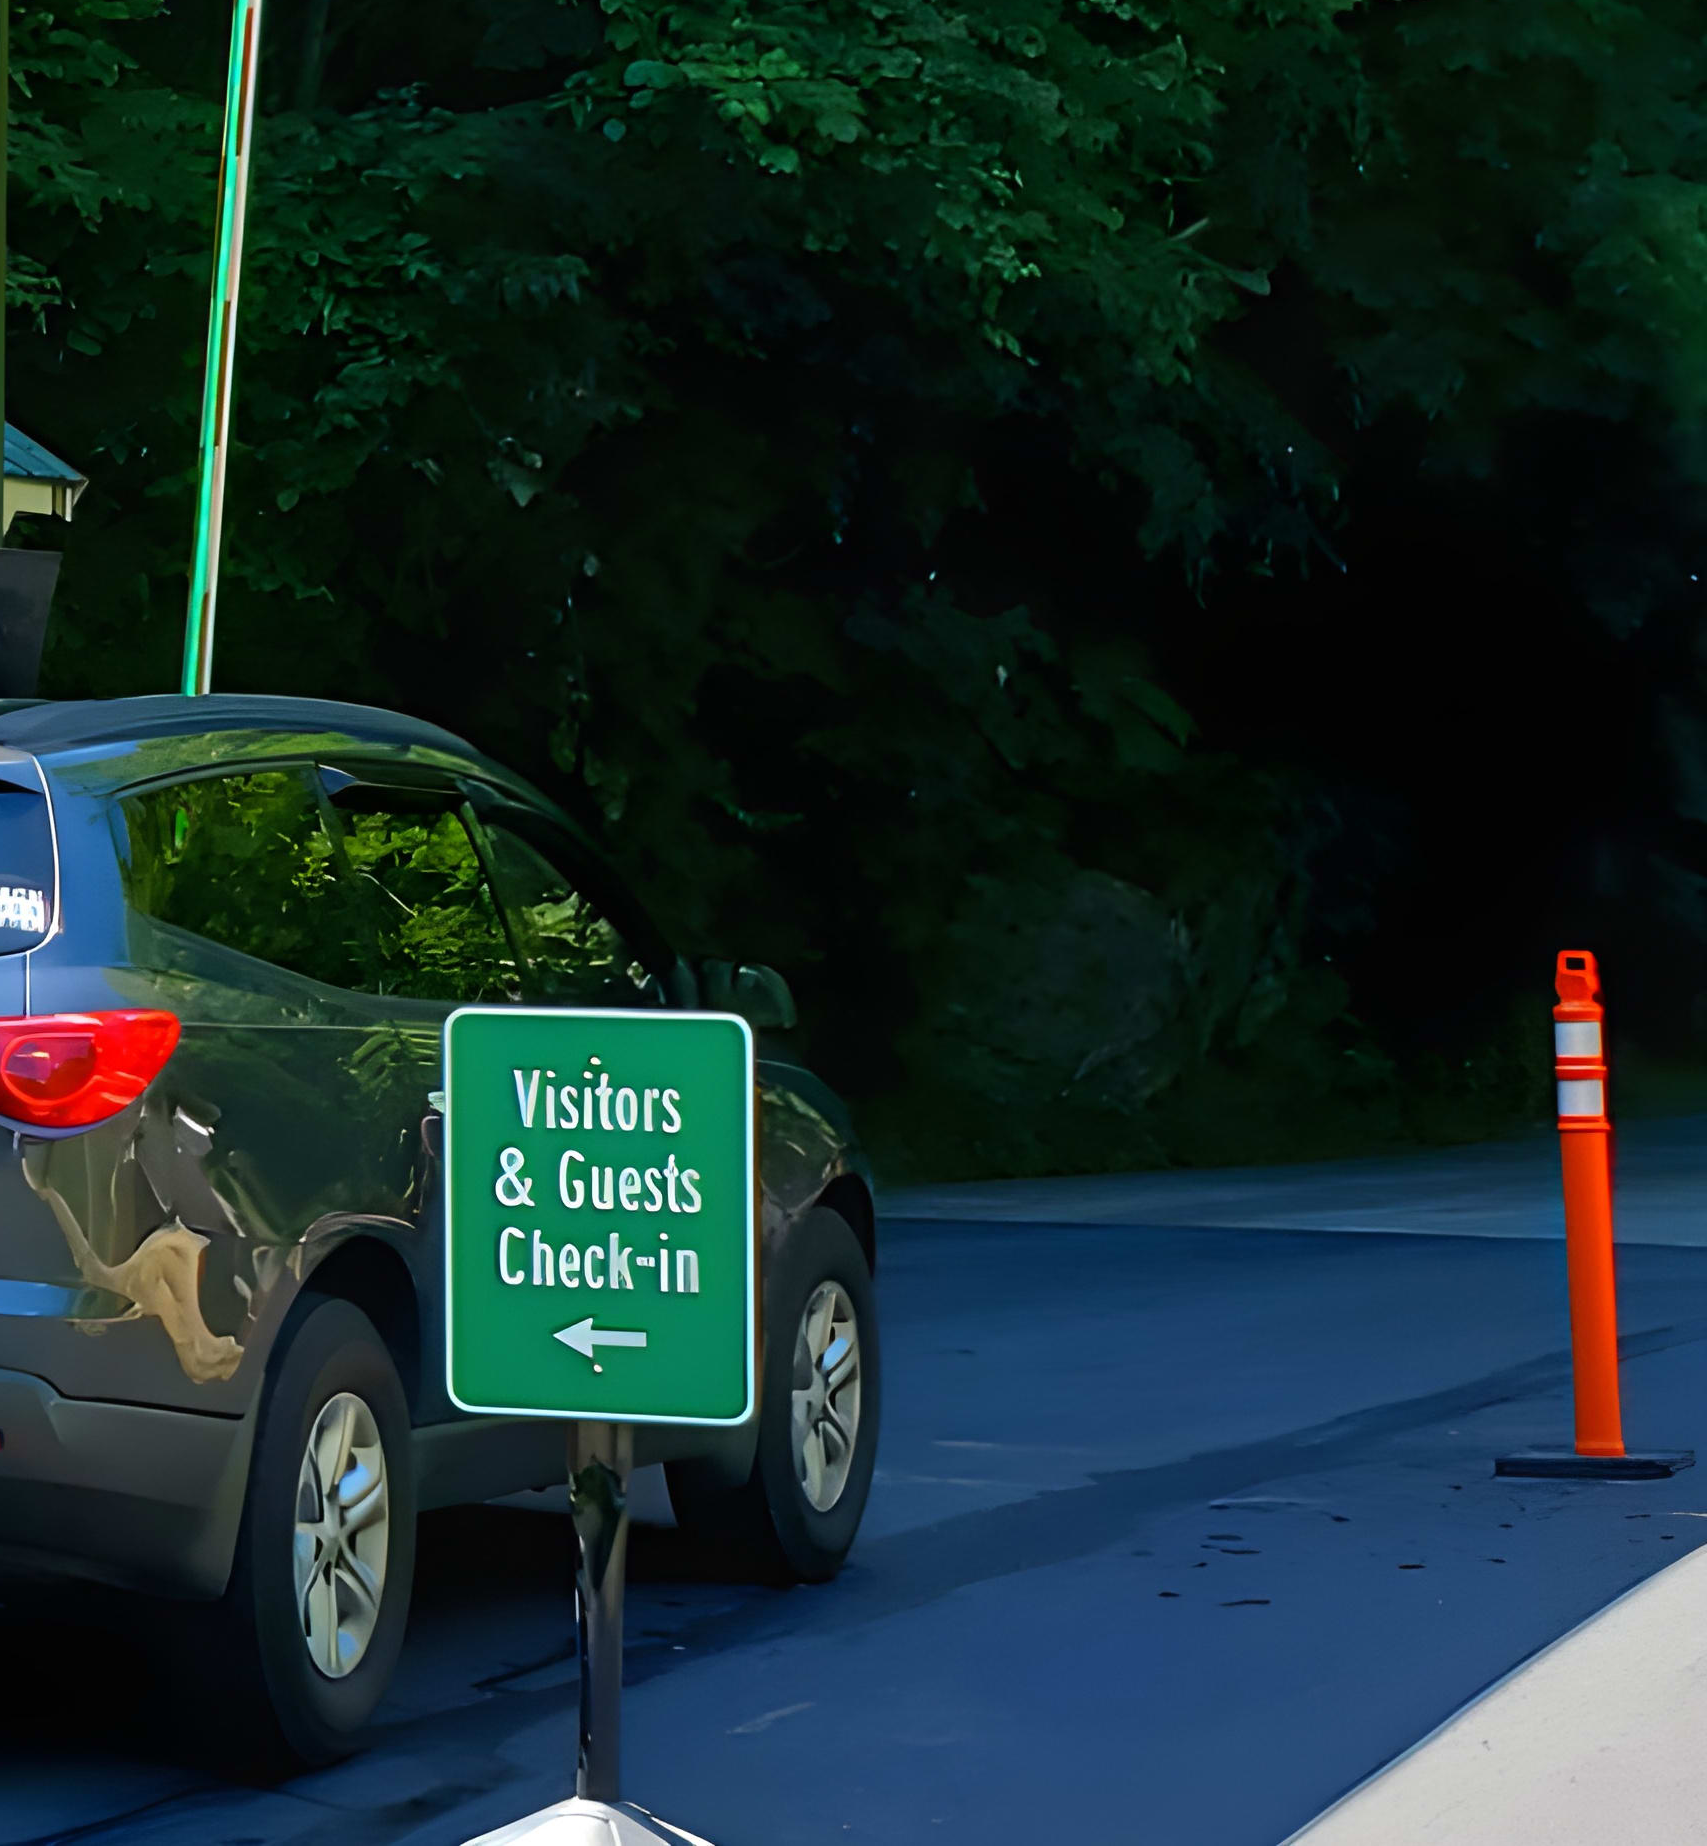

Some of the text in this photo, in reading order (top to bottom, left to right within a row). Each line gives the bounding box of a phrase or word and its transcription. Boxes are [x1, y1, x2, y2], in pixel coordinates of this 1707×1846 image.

[512, 1068, 683, 1134] Visitors
[494, 1145, 703, 1214] & Guests
[498, 1225, 700, 1294] Check-in
